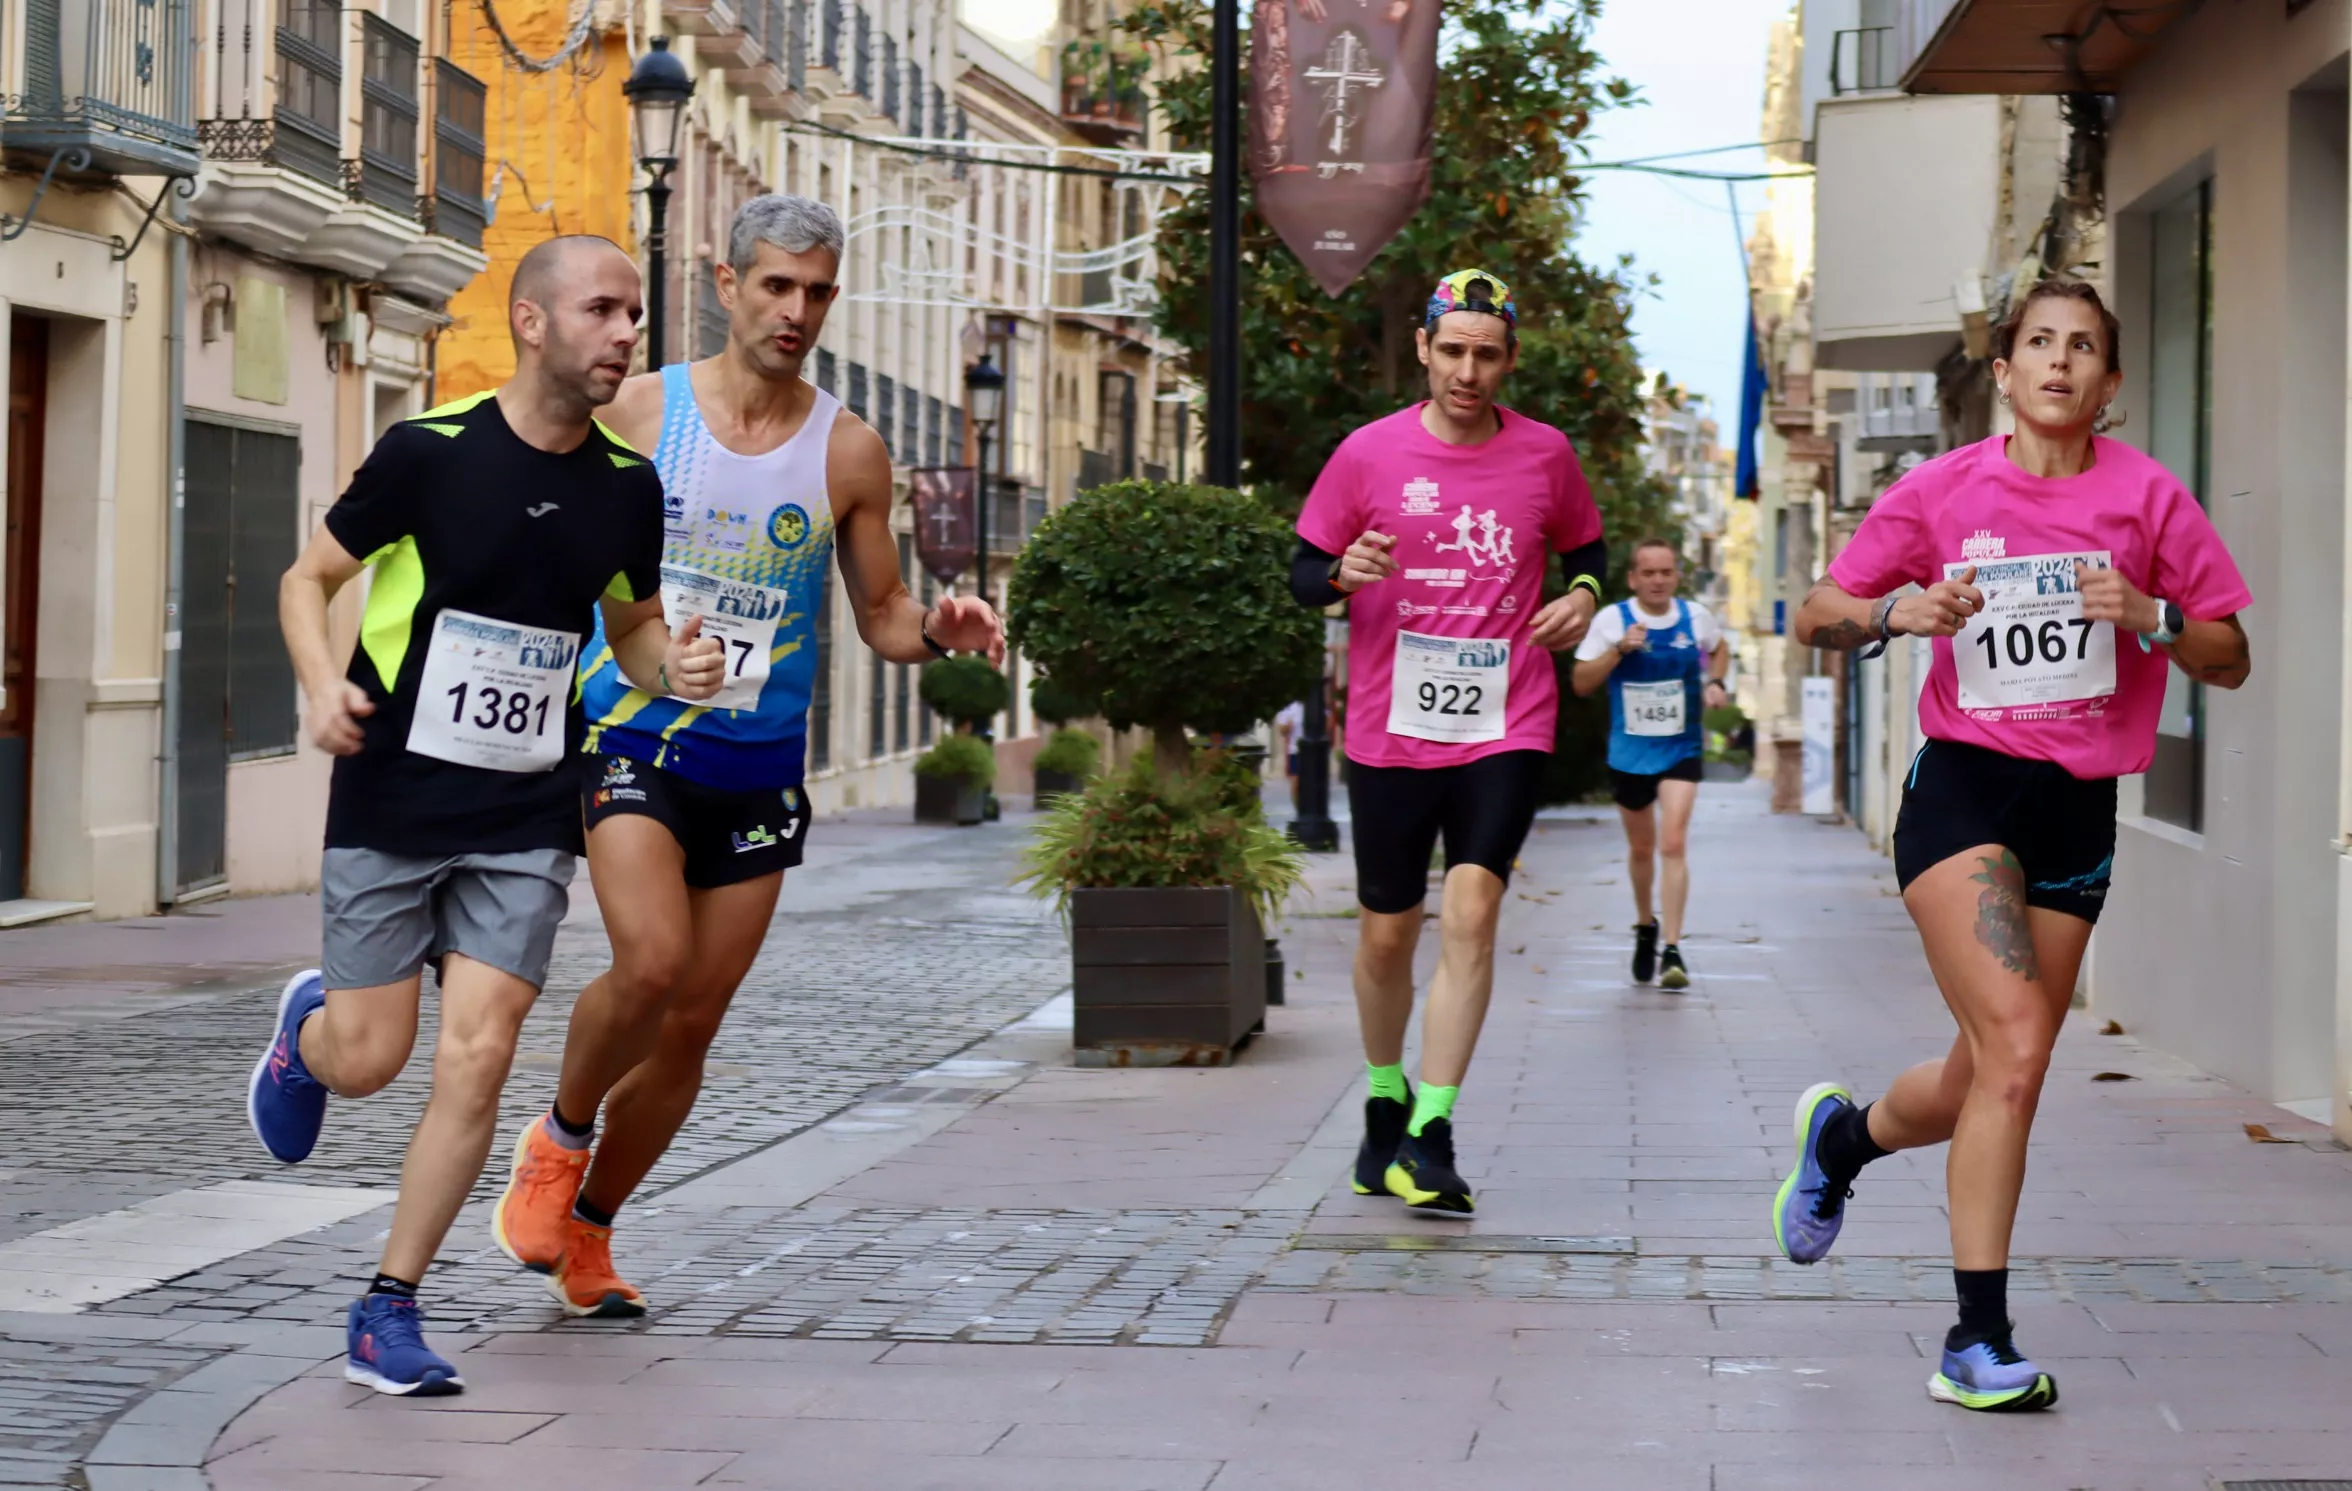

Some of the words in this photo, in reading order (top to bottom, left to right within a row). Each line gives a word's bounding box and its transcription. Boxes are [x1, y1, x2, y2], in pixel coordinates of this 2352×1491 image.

[2032, 558, 2075, 577] 2024
[1977, 619, 2095, 669] 1067
[447, 681, 550, 736] 1381
[1418, 682, 1483, 715] 922
[1634, 705, 1679, 722] 1484
